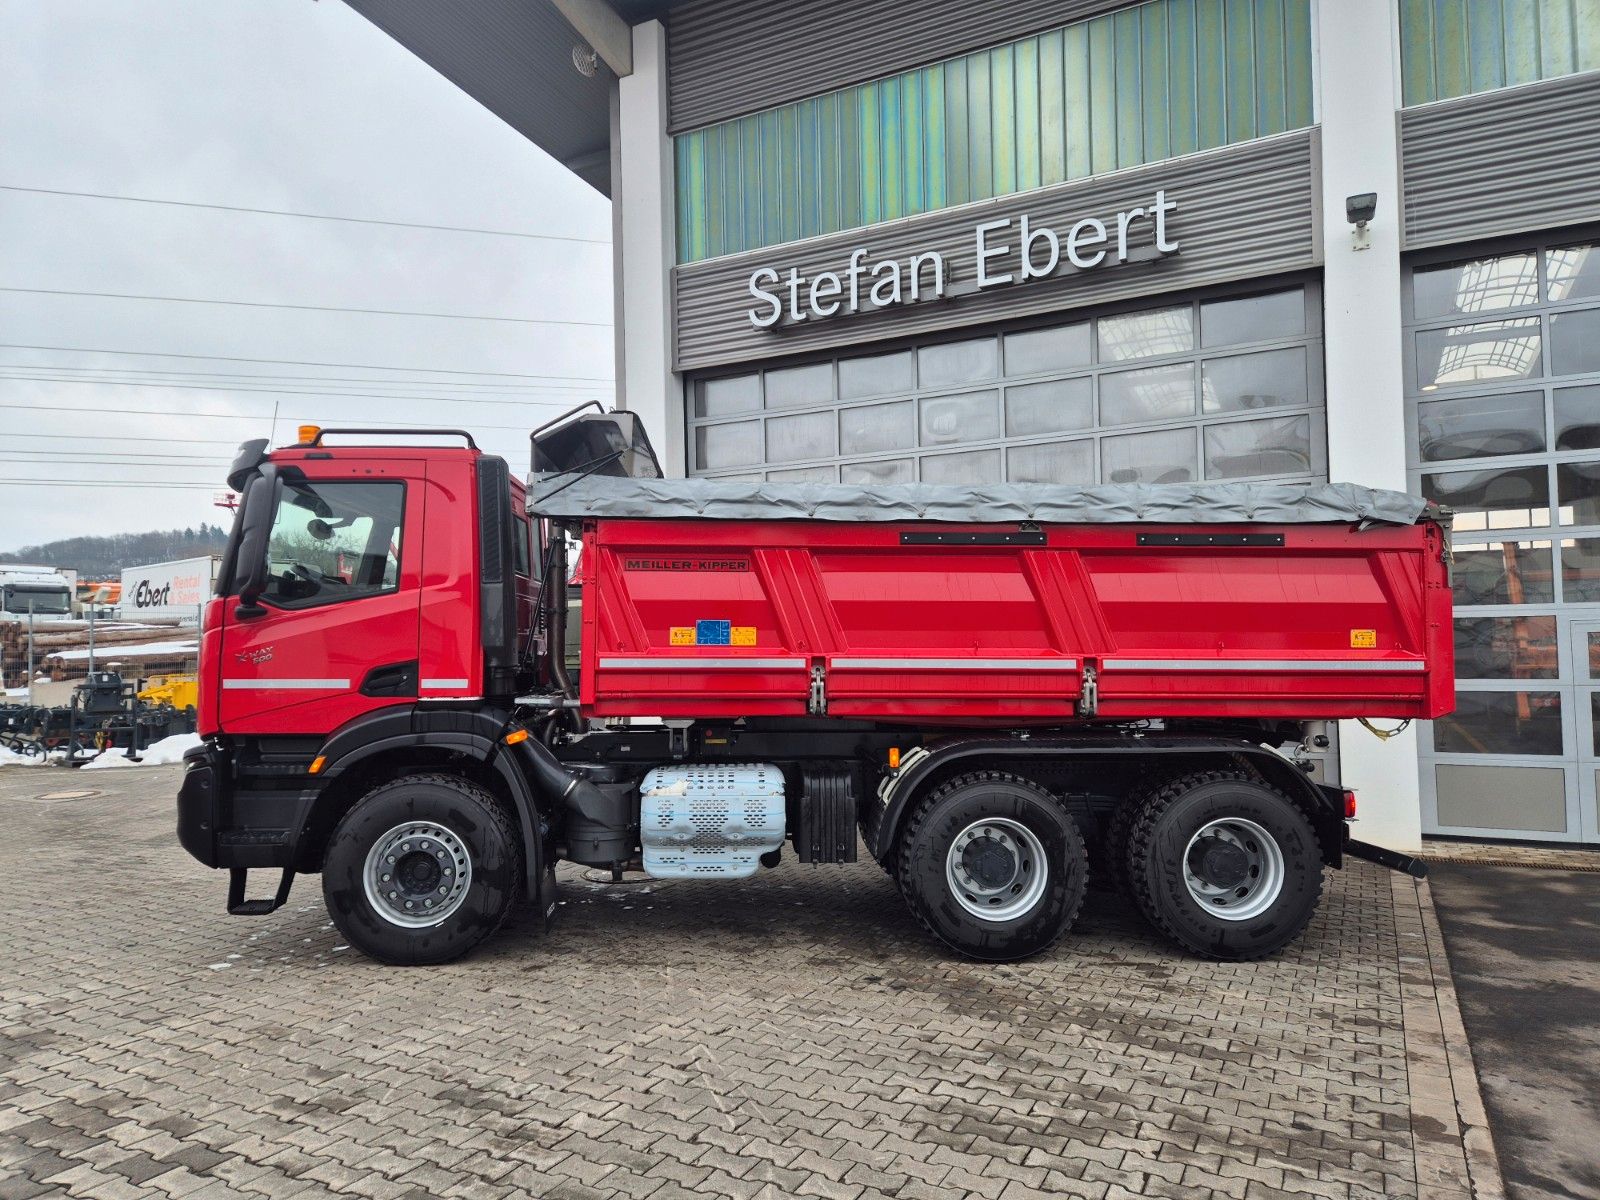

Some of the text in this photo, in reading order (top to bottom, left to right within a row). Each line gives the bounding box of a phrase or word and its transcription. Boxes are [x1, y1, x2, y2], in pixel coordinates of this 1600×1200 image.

[748, 190, 1180, 328] Stefan Ebert
[173, 575, 200, 589] Rental
[136, 580, 170, 608] Ebert
[178, 591, 200, 604] Sales
